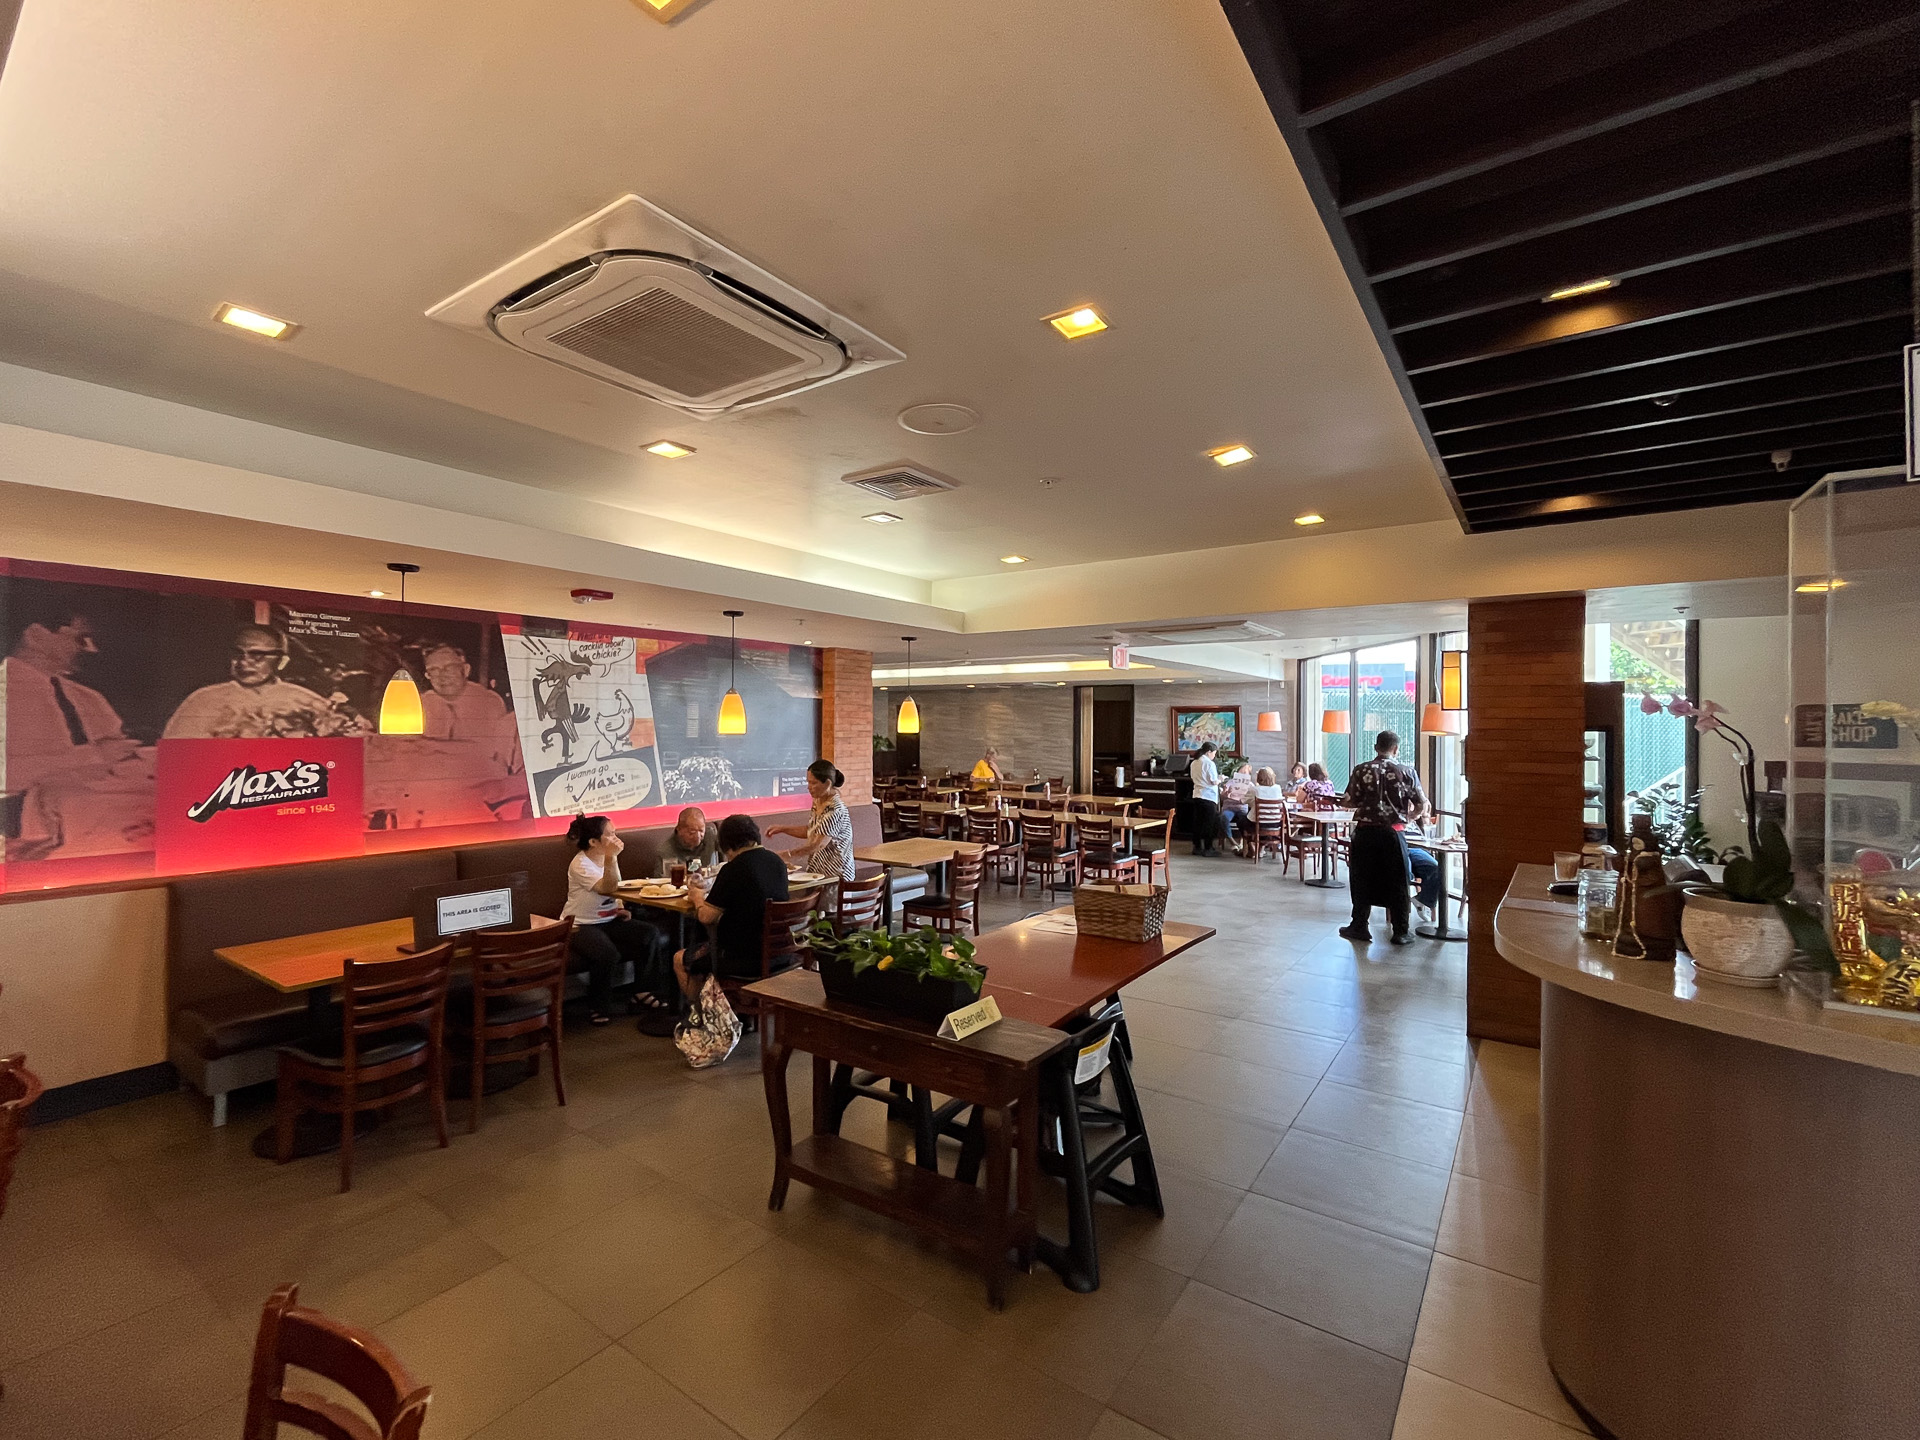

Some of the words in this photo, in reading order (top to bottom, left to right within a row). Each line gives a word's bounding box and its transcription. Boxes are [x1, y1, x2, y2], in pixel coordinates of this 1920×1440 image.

[305, 619, 330, 628] friends
[570, 768, 597, 779] wanna
[598, 764, 609, 776] go
[187, 760, 321, 818] Max's
[241, 786, 321, 804] RESTAURANT
[565, 783, 574, 793] to
[571, 772, 626, 803] Max's
[276, 806, 306, 815] since
[309, 803, 336, 813] 1945
[456, 908, 472, 916] AREA
[479, 904, 501, 912] CLOSED
[952, 1007, 988, 1031] Reserved
